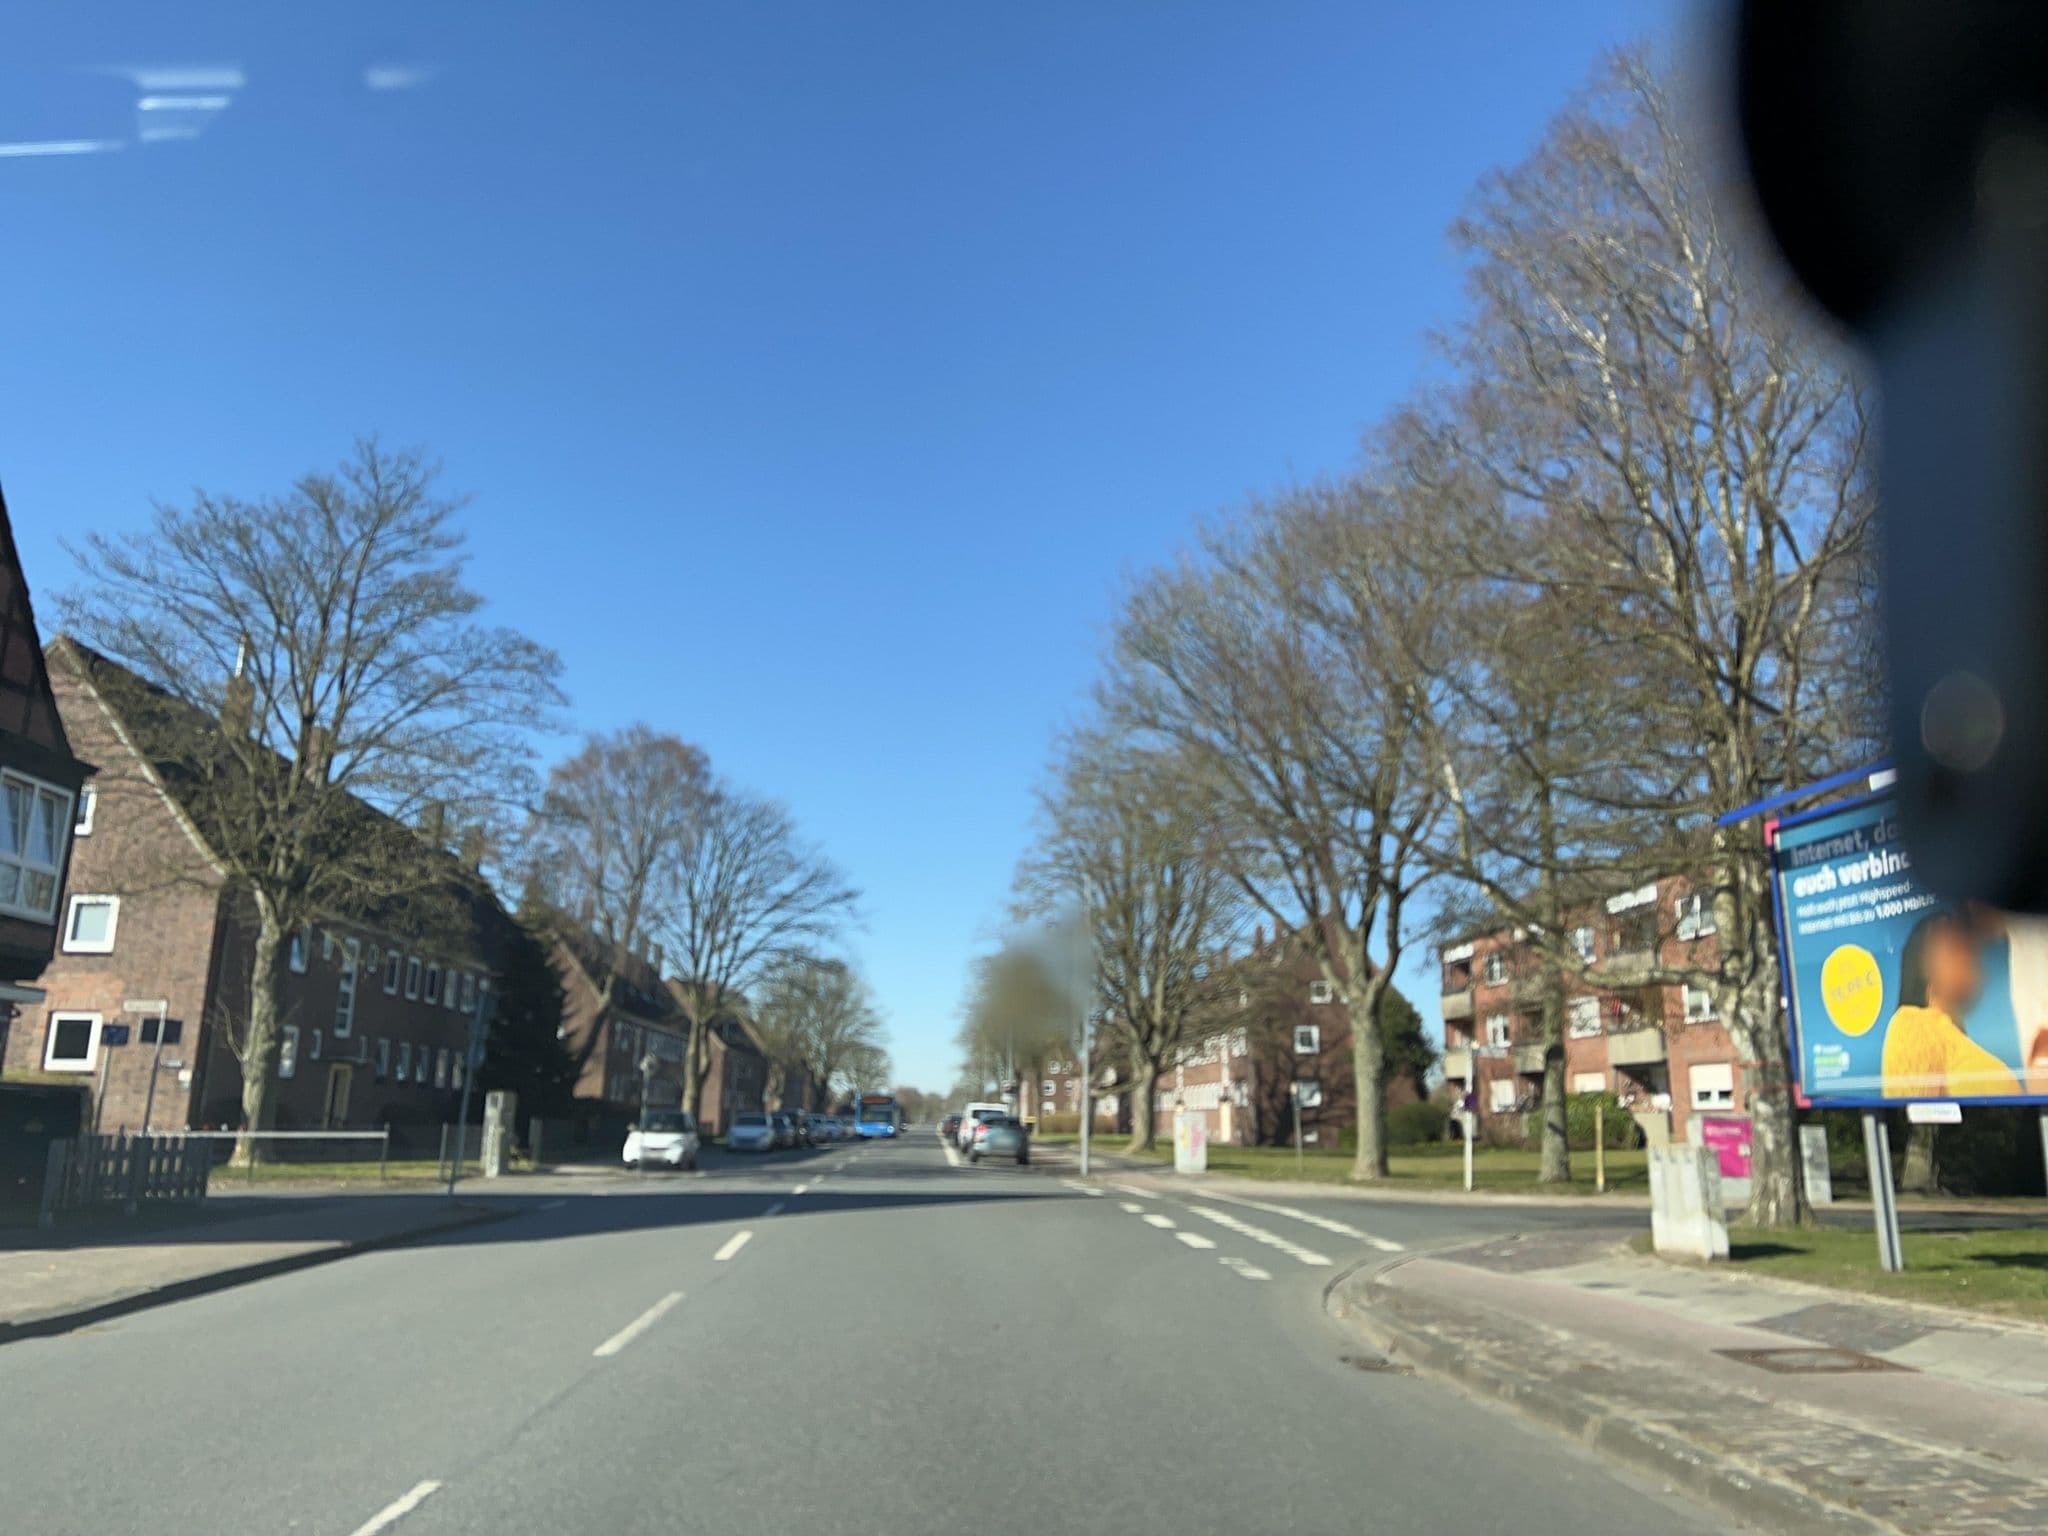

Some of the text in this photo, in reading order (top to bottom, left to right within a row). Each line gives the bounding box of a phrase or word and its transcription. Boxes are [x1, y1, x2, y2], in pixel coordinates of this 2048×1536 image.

[1791, 817, 1900, 866] Internet, da
[1793, 863, 1837, 898] euch
